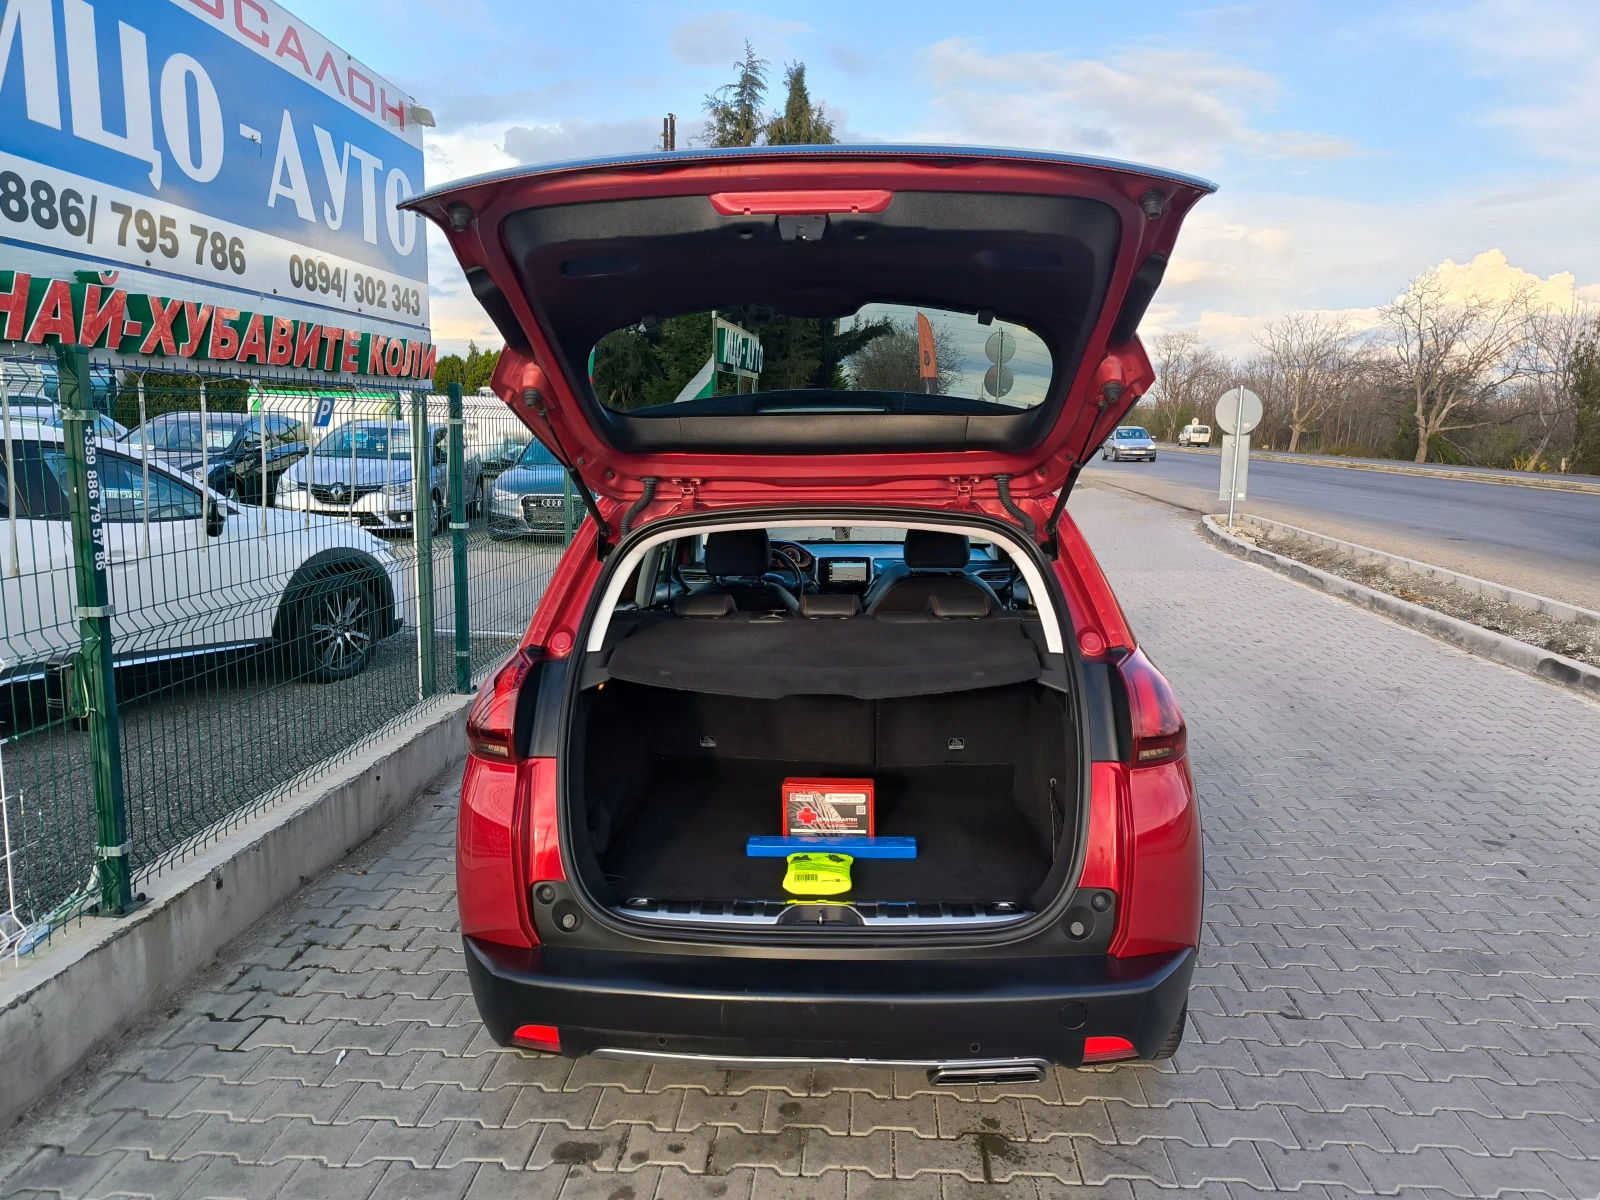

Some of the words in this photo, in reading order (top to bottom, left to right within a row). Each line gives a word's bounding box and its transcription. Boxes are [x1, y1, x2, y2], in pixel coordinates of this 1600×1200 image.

[188, 0, 404, 132] САЛОН
[111, 201, 179, 258] 795
[190, 224, 246, 275] 786
[289, 254, 347, 302] 0894/
[354, 273, 387, 308] 302
[392, 284, 420, 316] 343
[367, 333, 437, 380] КОЛИ
[316, 401, 331, 424] P
[85, 425, 96, 465] +359
[87, 470, 99, 499] 886
[90, 503, 101, 523] 79
[92, 528, 104, 546] 57
[94, 551, 106, 571] 86
